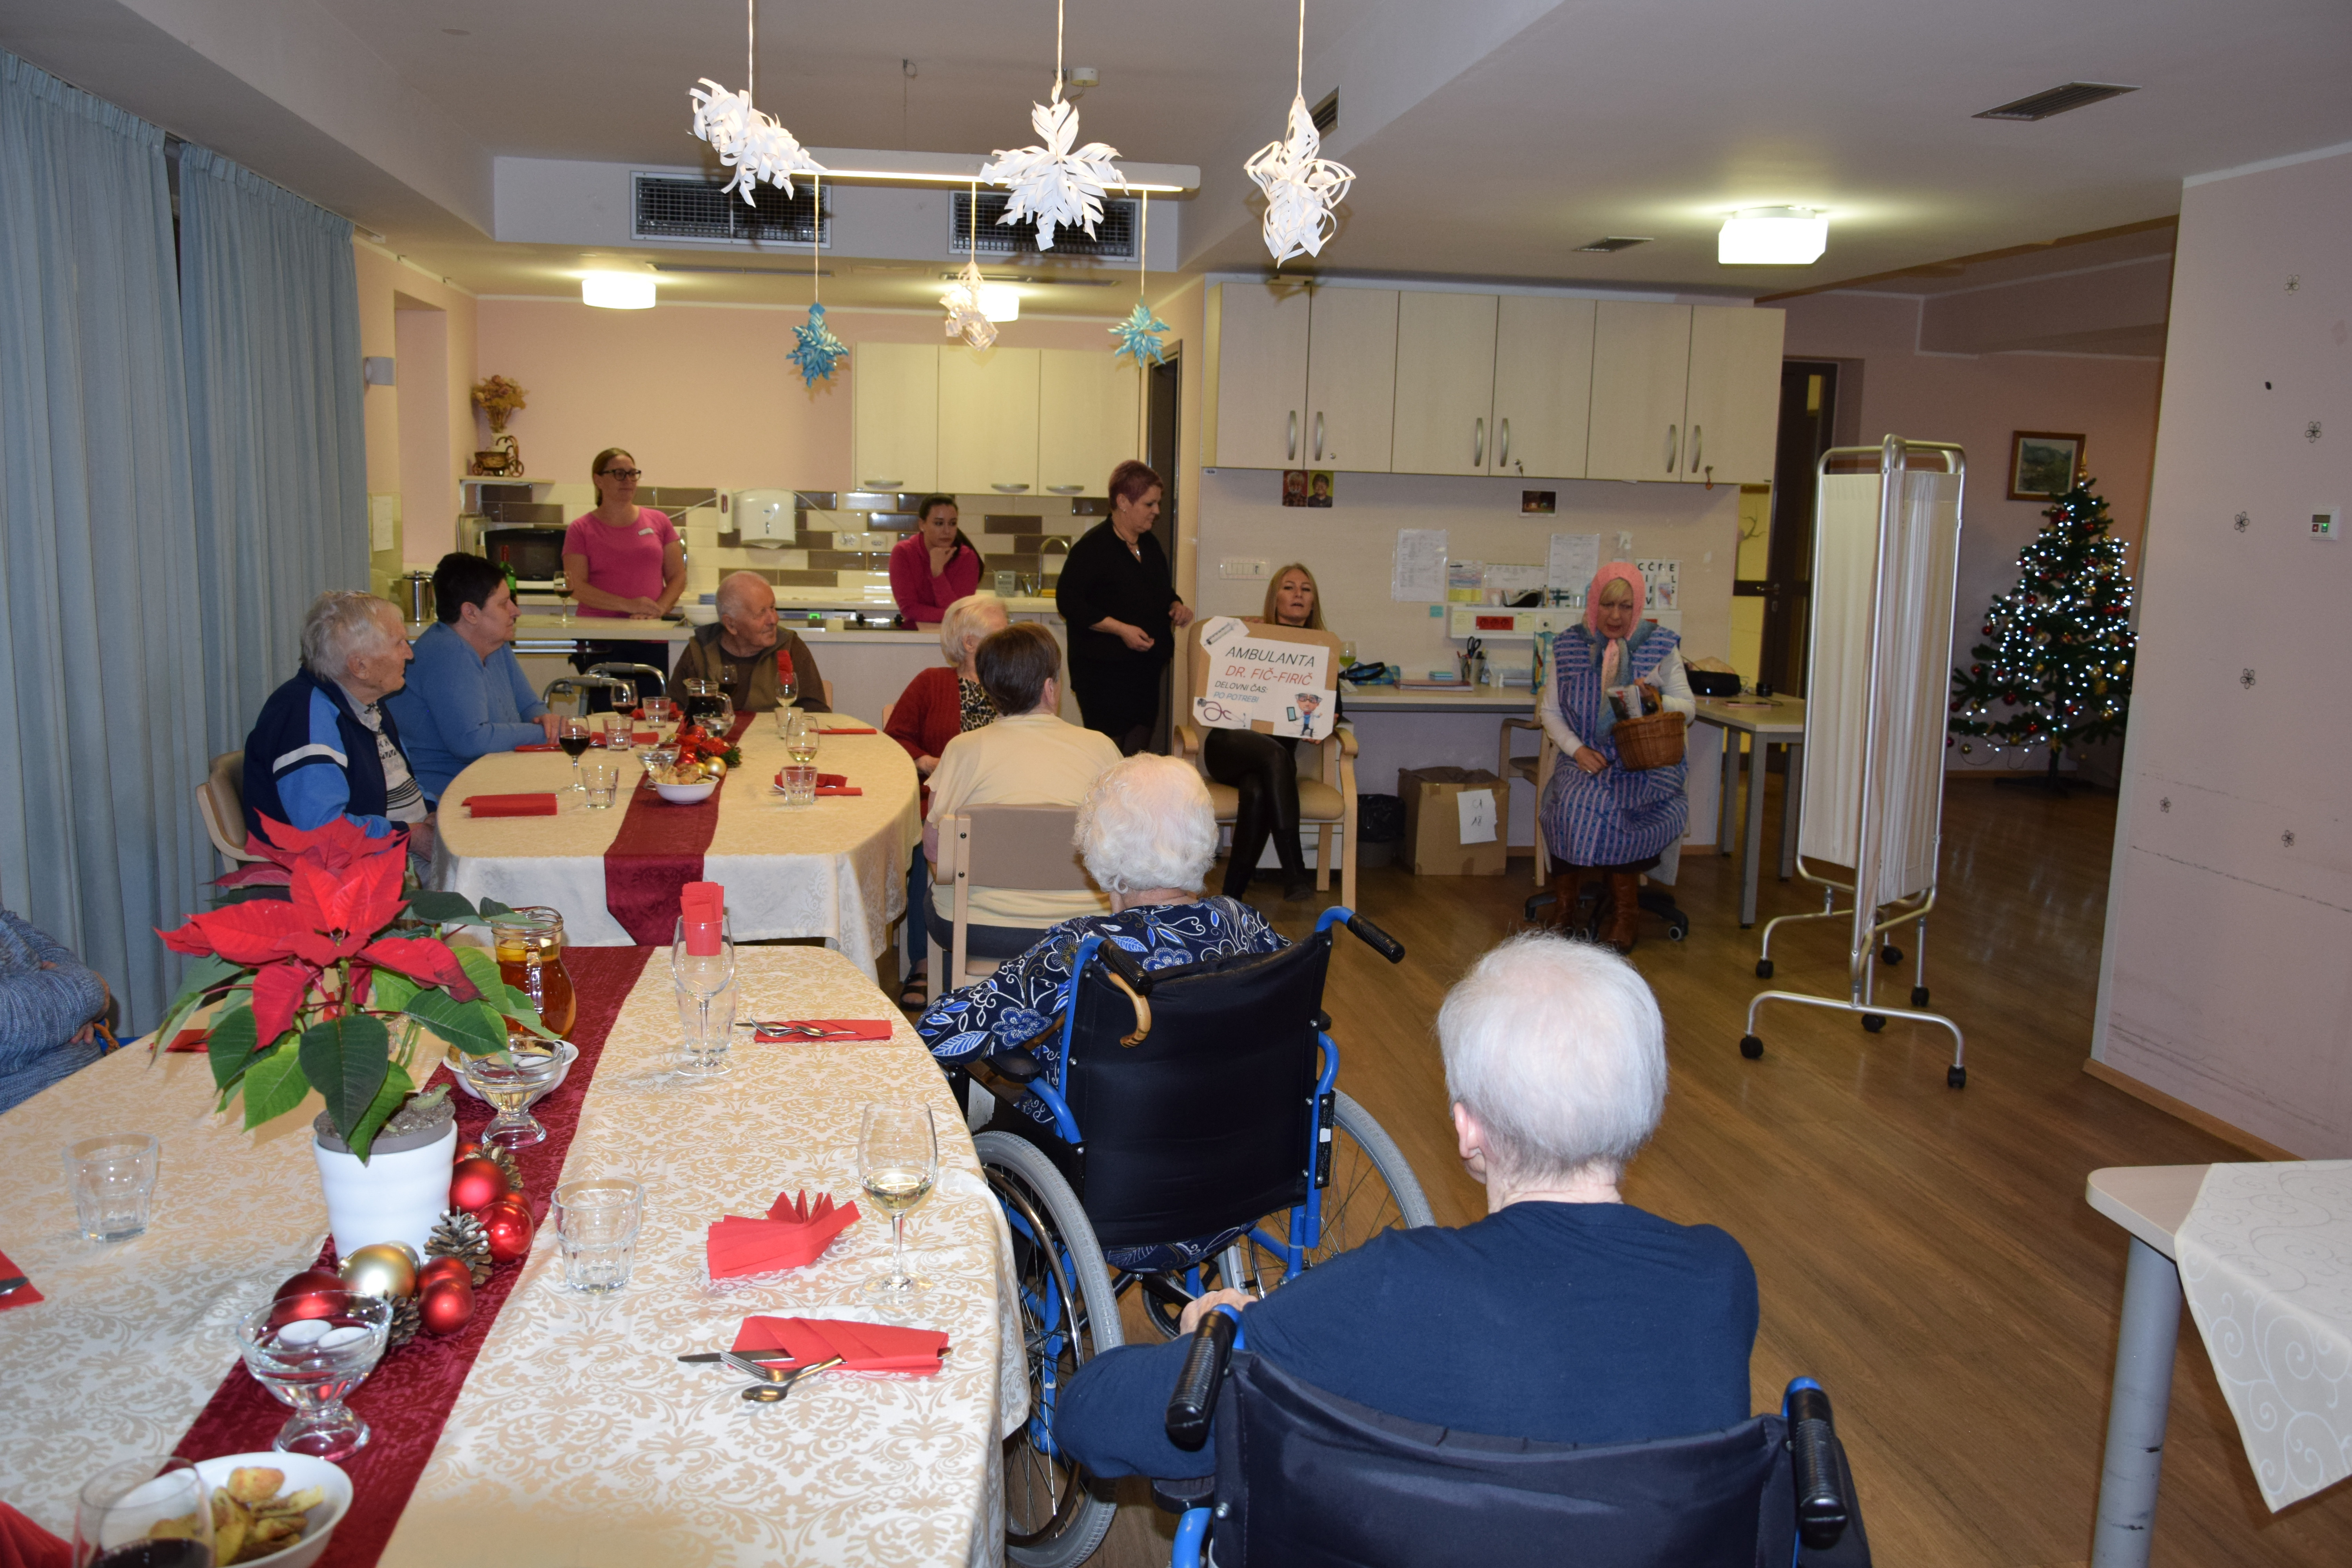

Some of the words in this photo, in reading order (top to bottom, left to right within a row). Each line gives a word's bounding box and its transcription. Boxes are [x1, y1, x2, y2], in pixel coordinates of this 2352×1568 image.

[1225, 646, 1315, 667] AMBULANTA
[1225, 665, 1245, 678] DR.
[1250, 667, 1313, 685] FIČ-FIRIČ
[1214, 681, 1250, 691] DELOVNI
[1250, 684, 1268, 693] ČAS:
[1226, 693, 1259, 703] POTREBI
